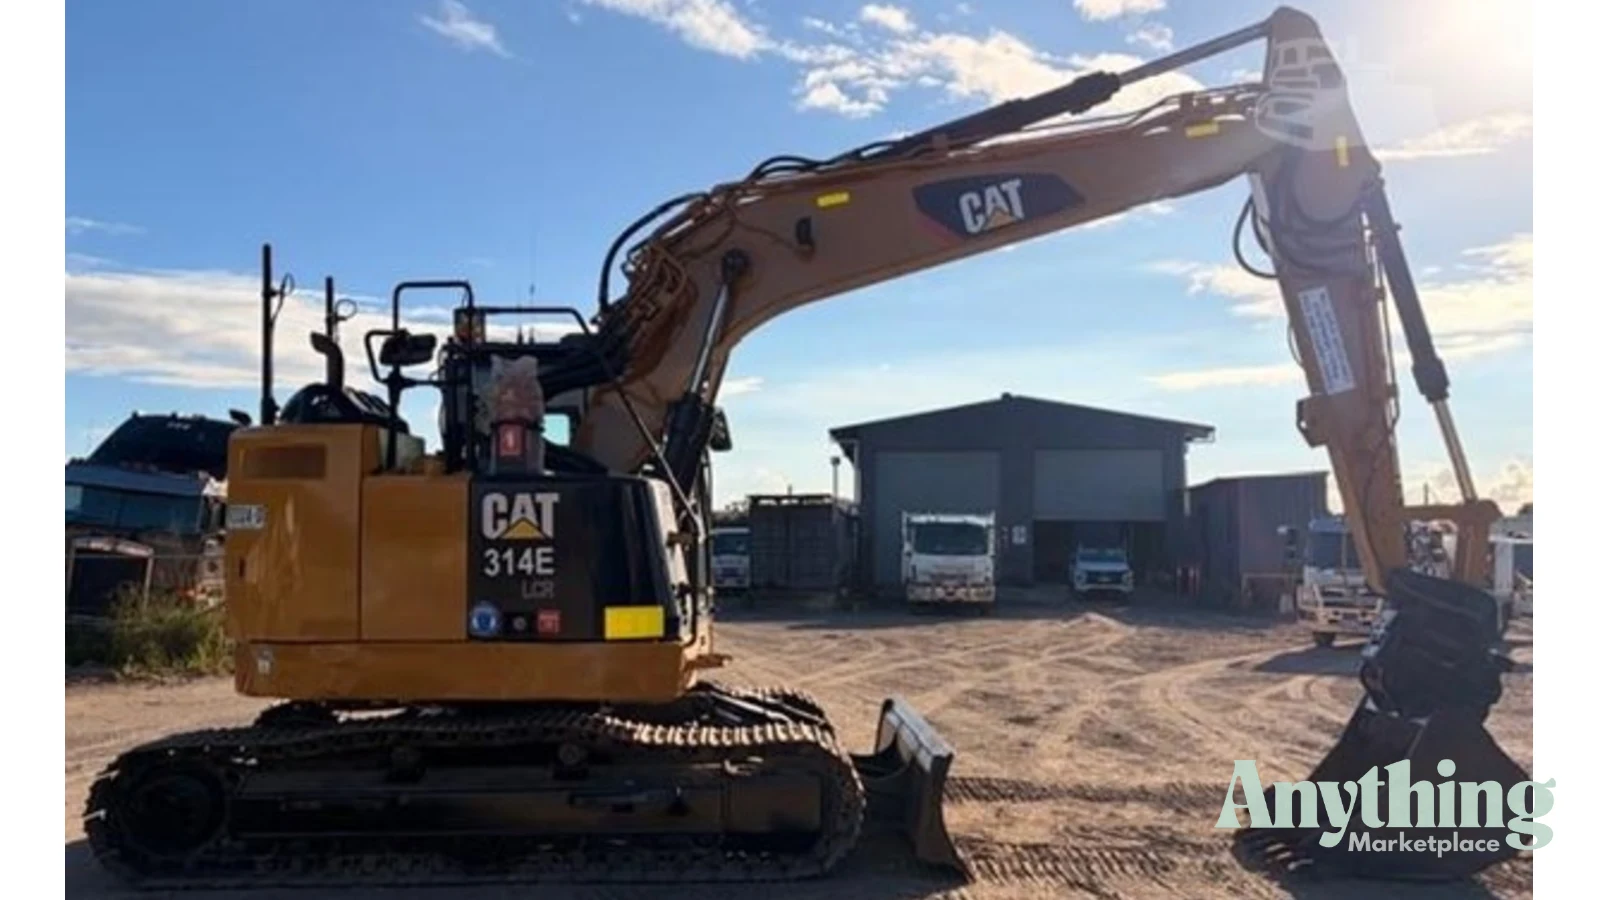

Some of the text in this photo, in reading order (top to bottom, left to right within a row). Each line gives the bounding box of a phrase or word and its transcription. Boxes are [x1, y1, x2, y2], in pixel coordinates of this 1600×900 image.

[959, 179, 1024, 233] CAT
[482, 492, 560, 540] CAT
[484, 547, 555, 576] 314E
[521, 580, 554, 599] LCR
